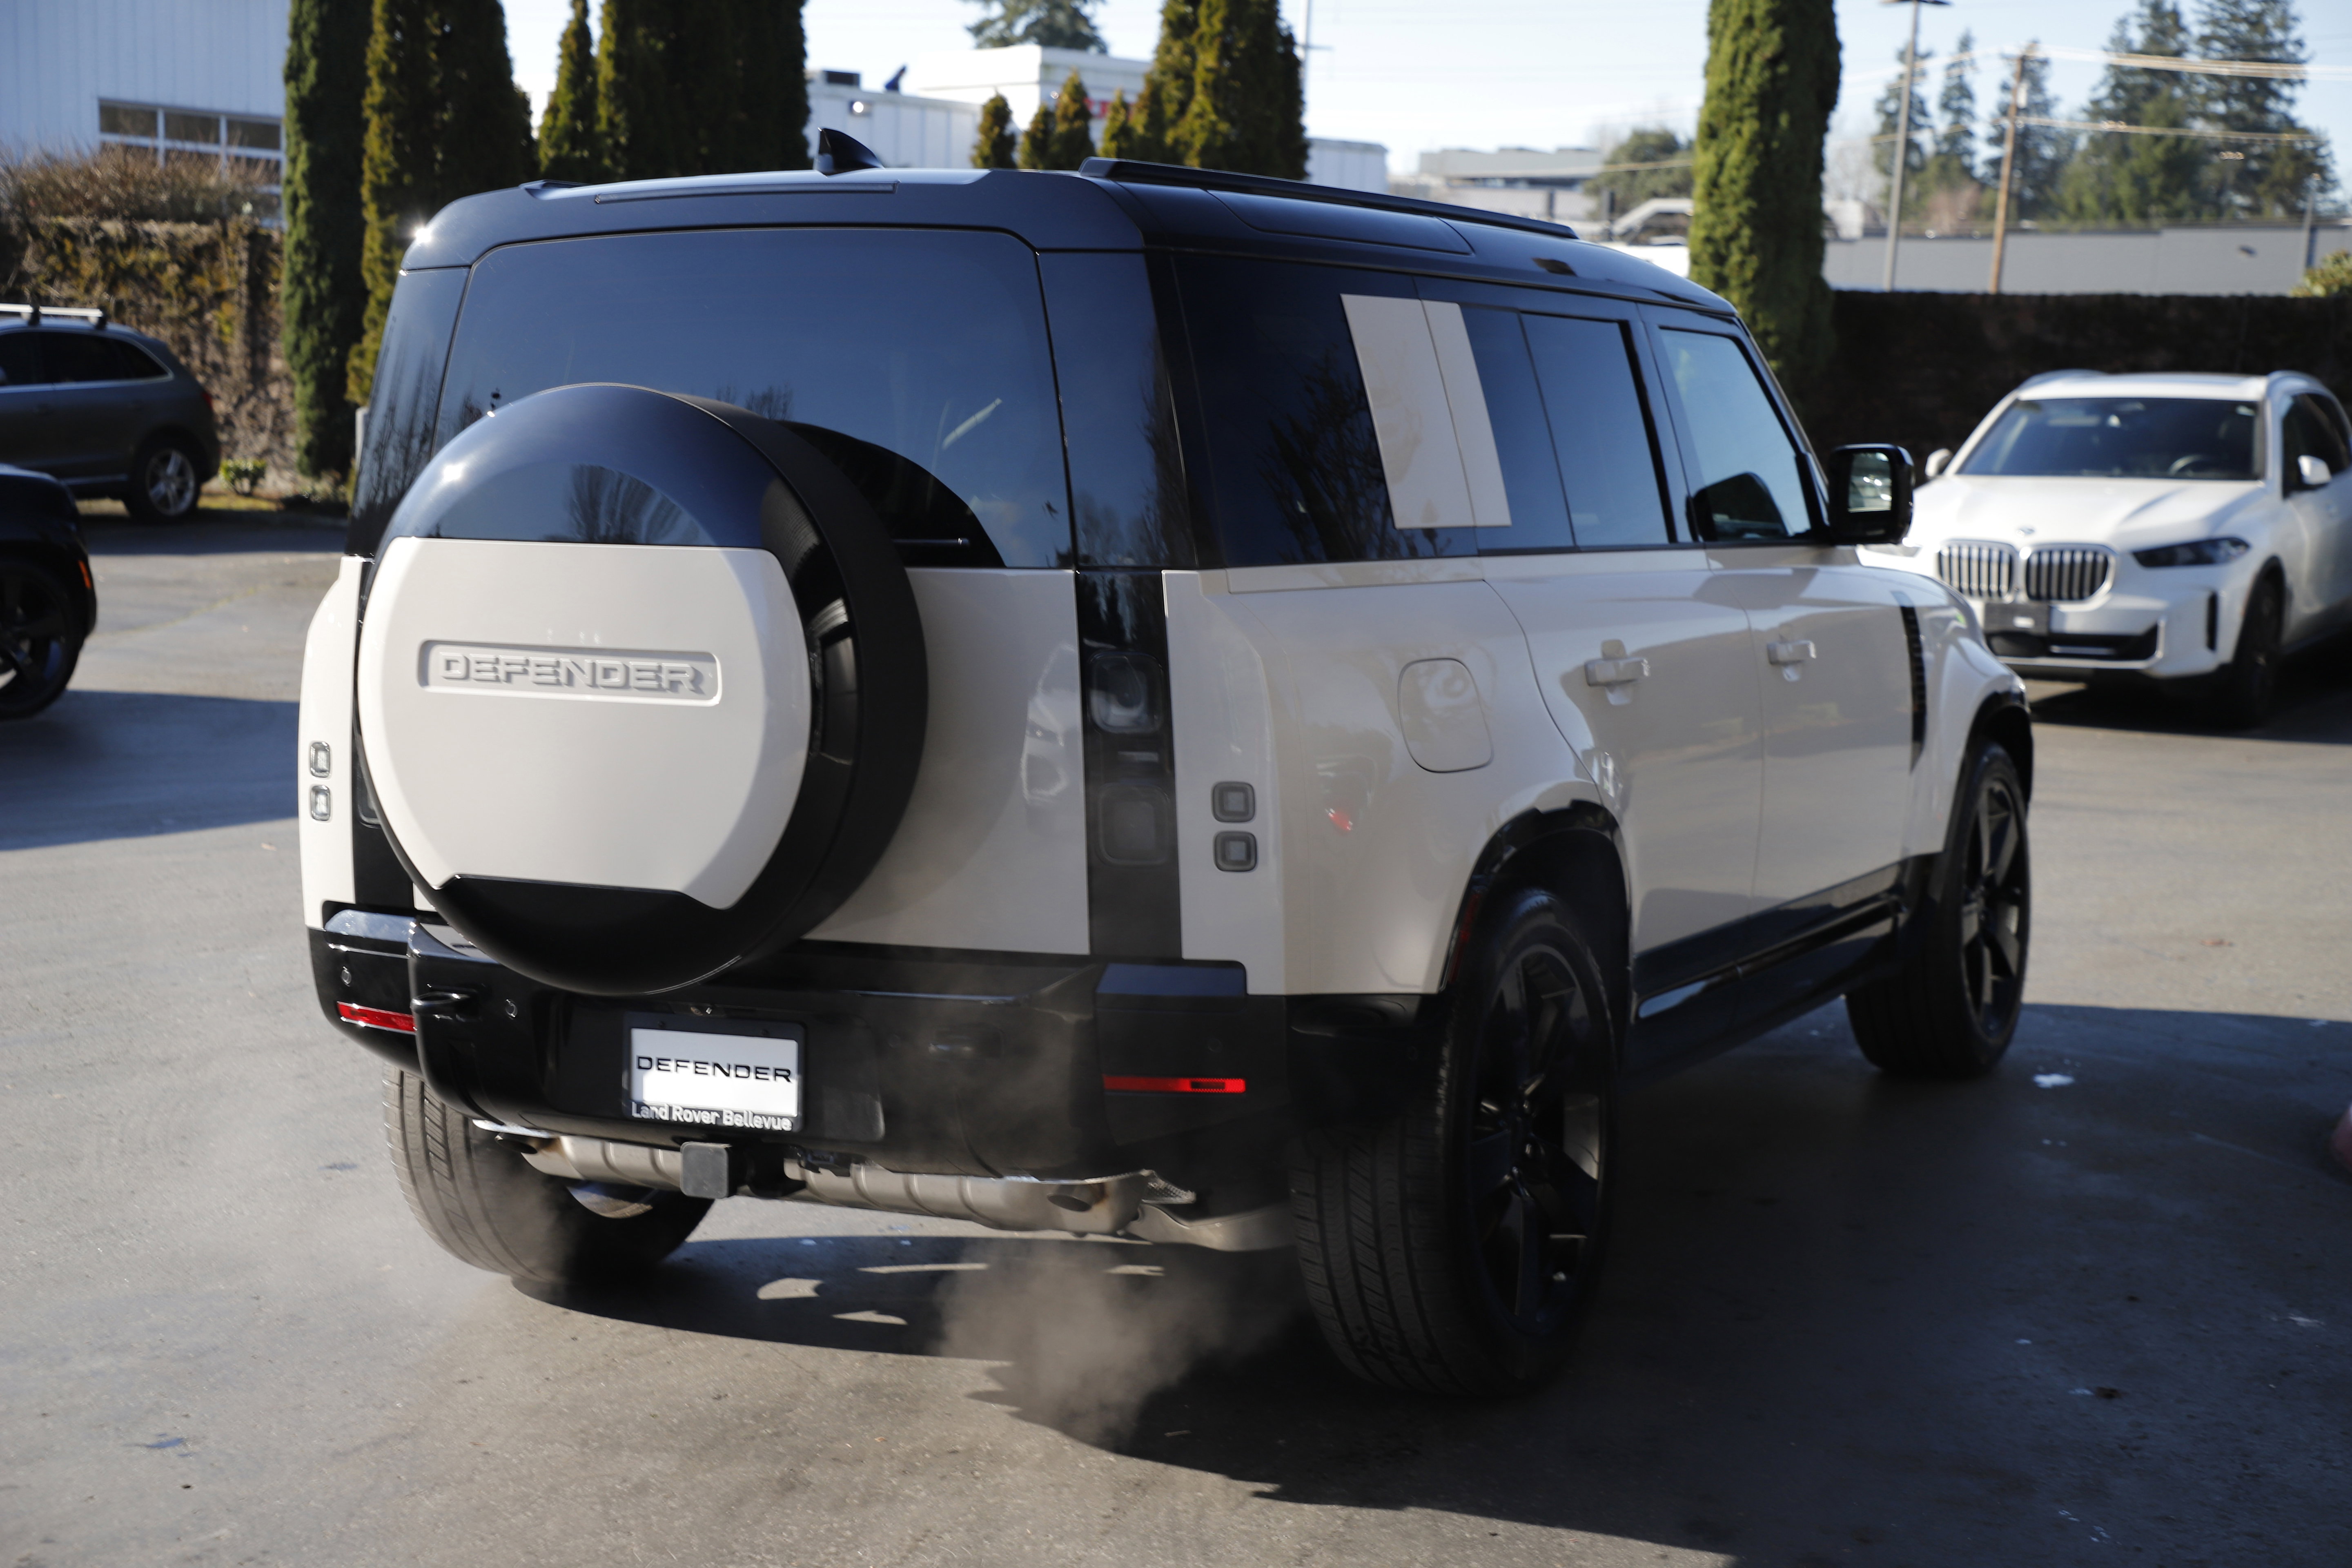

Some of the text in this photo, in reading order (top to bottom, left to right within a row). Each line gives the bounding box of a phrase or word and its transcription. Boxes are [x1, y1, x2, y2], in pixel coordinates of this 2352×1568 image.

[440, 653, 697, 691] DEFENDER
[637, 1056, 791, 1082] DEFENDER
[631, 1101, 793, 1131] Land Rover Bellevue
